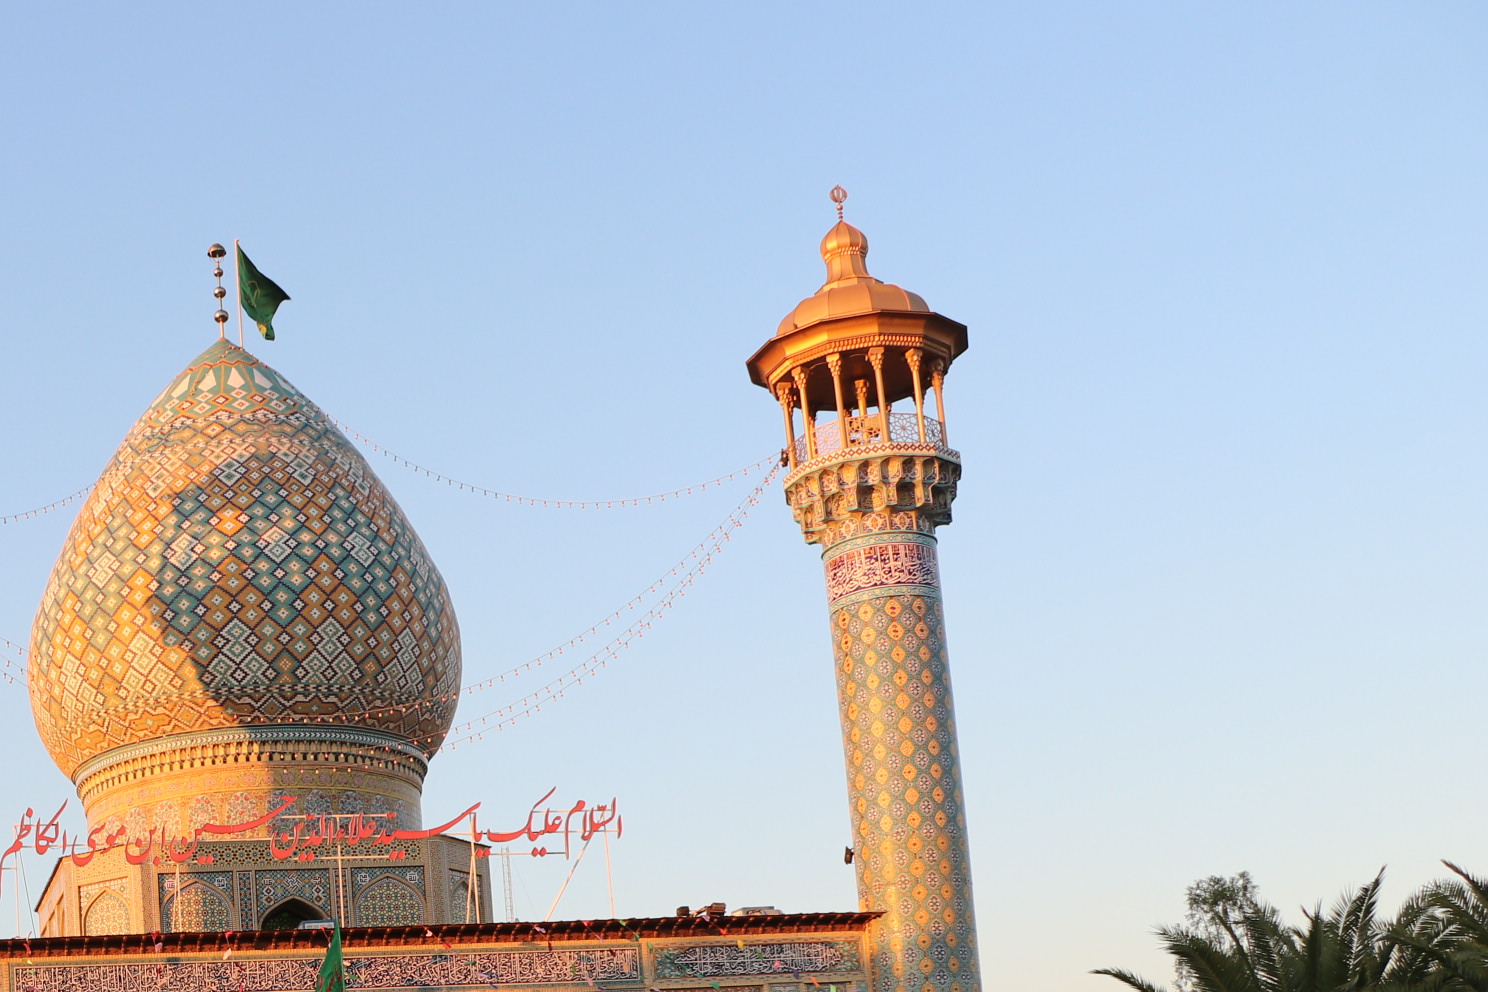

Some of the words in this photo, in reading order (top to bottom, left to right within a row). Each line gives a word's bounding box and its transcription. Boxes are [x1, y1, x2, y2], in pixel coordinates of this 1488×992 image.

[71, 823, 126, 867] موسی
[124, 823, 166, 866] ابن
[168, 794, 299, 865] حسین
[372, 802, 482, 861] سید
[473, 812, 491, 860] یا
[486, 786, 563, 859] علیک
[565, 797, 623, 861] السلام
